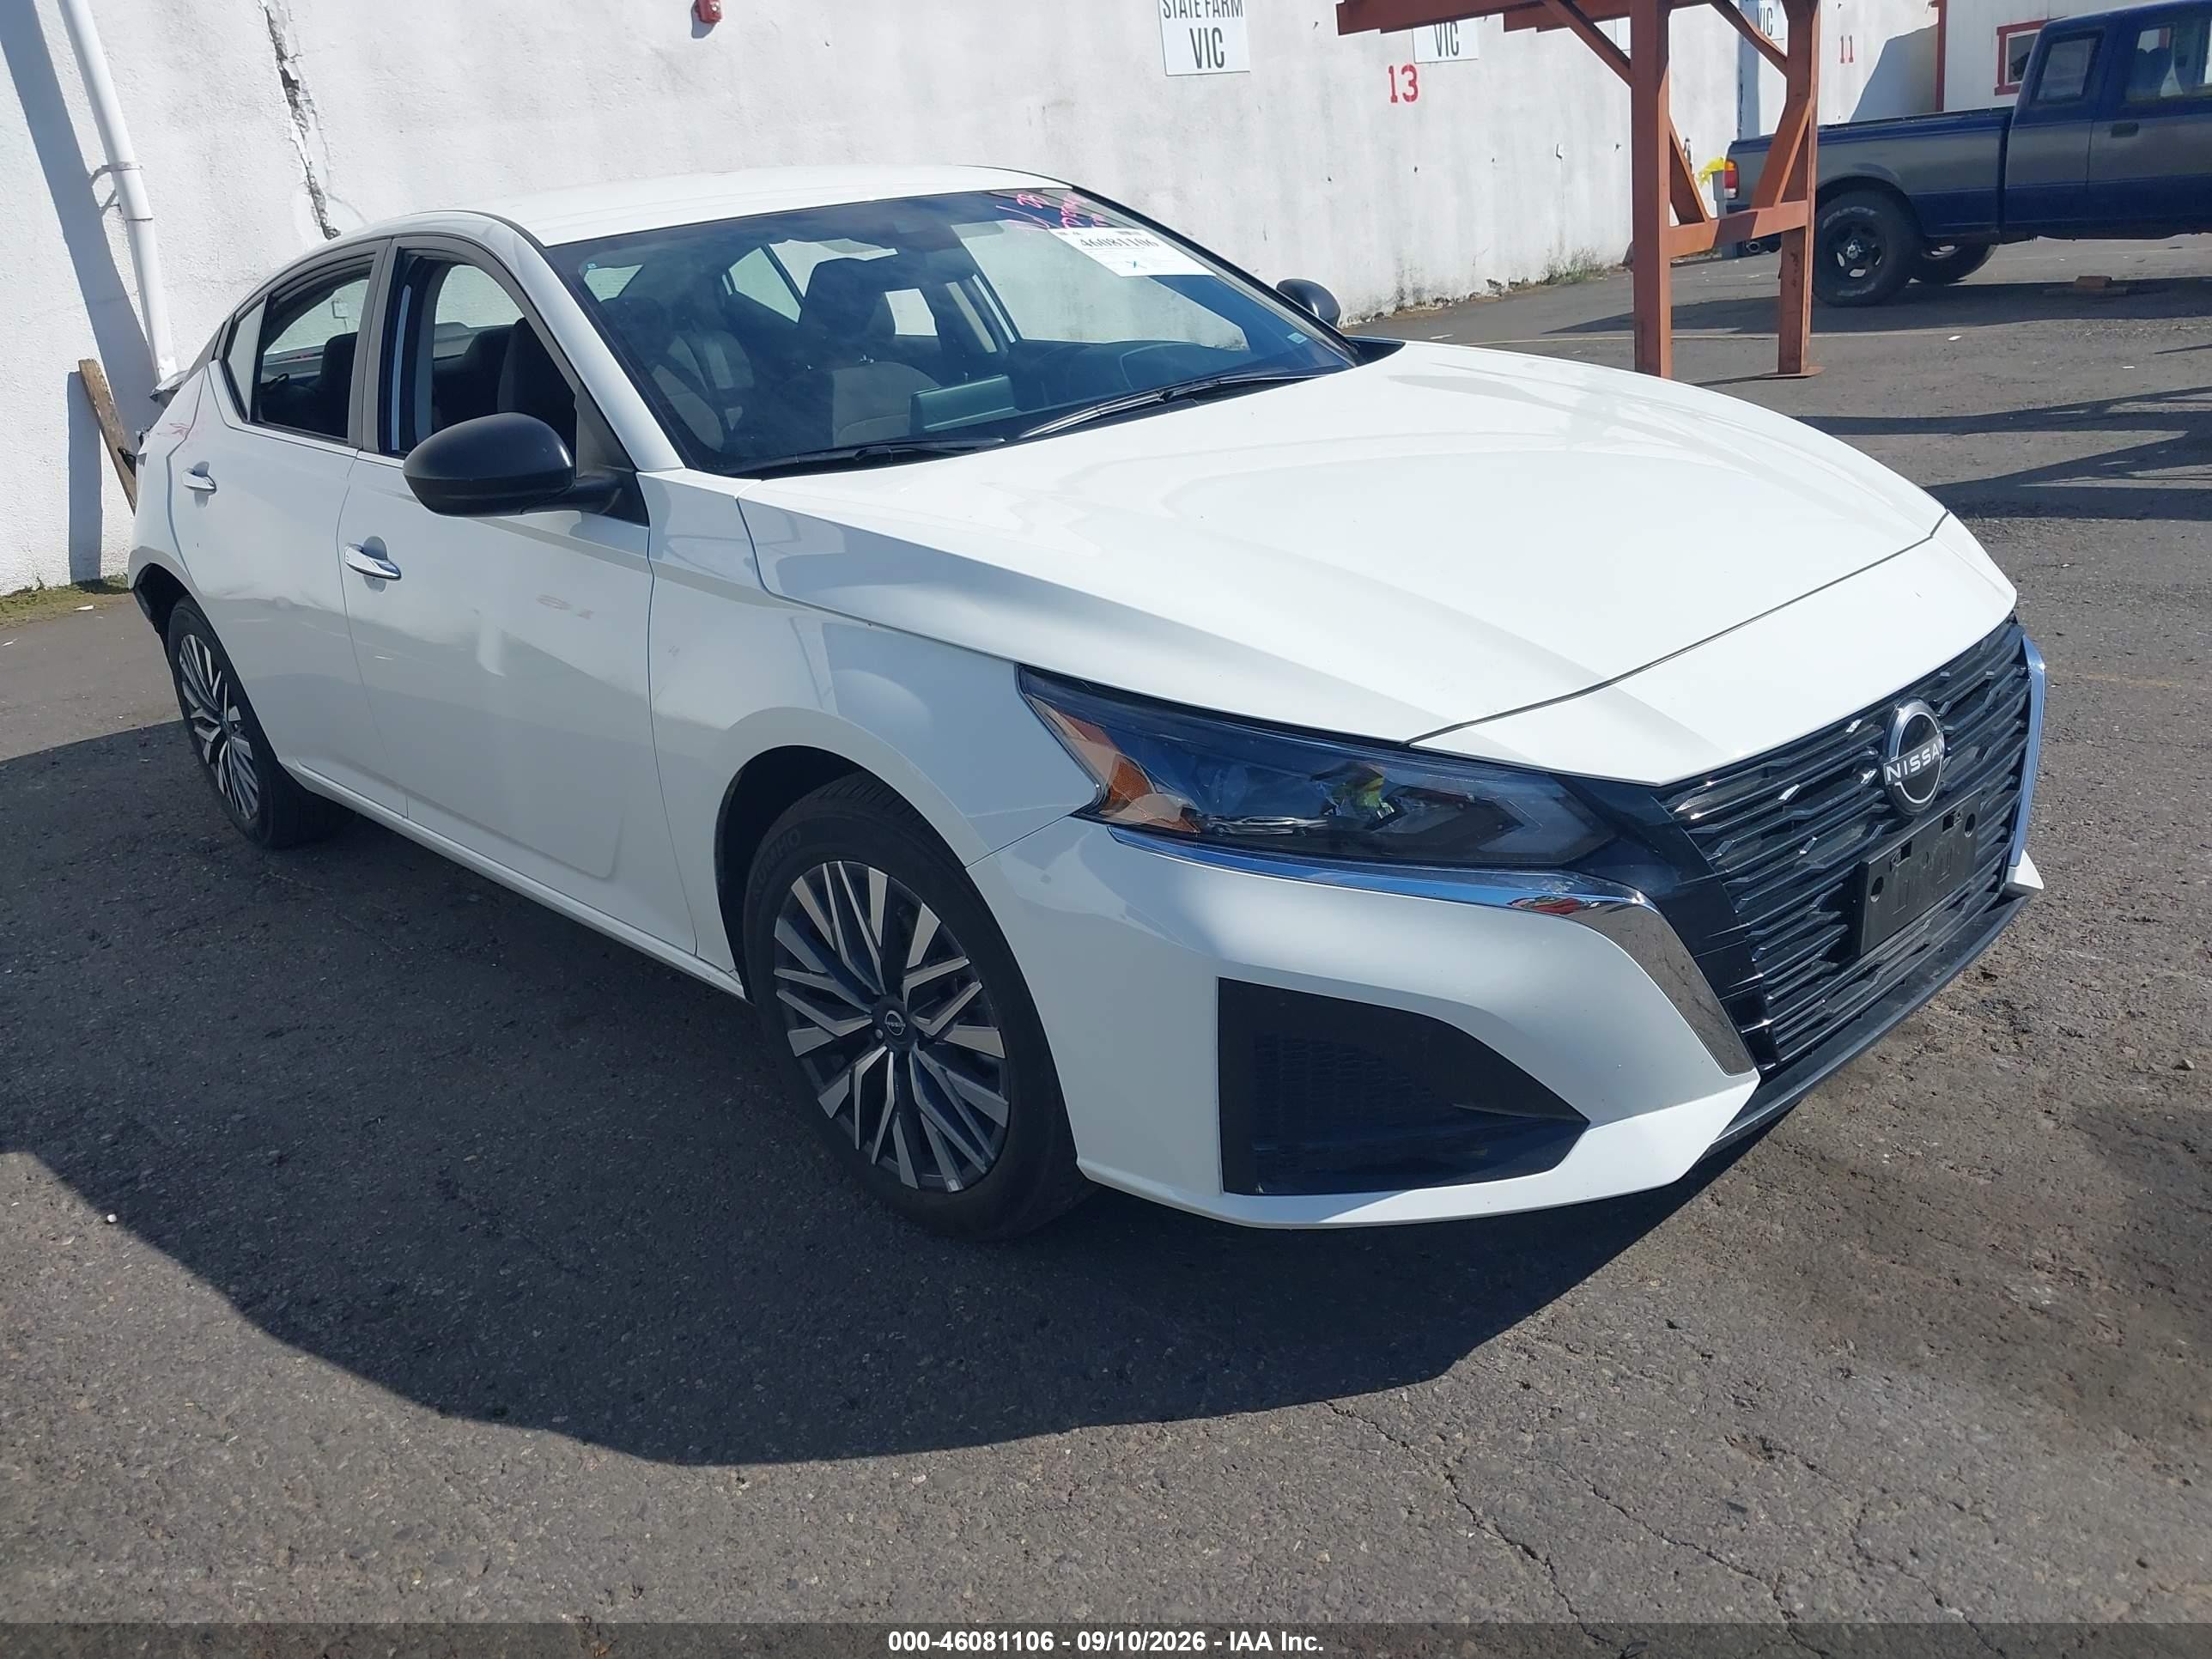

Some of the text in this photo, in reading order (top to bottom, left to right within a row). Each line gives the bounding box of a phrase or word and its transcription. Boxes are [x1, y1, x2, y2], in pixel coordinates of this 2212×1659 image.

[1189, 27, 1224, 69] VIC
[1434, 21, 1459, 57] VIC
[1840, 34, 1854, 64] 11
[1389, 64, 1419, 103] 13
[1079, 238, 1159, 247] 46081106
[1887, 738, 1945, 781] NISSAN
